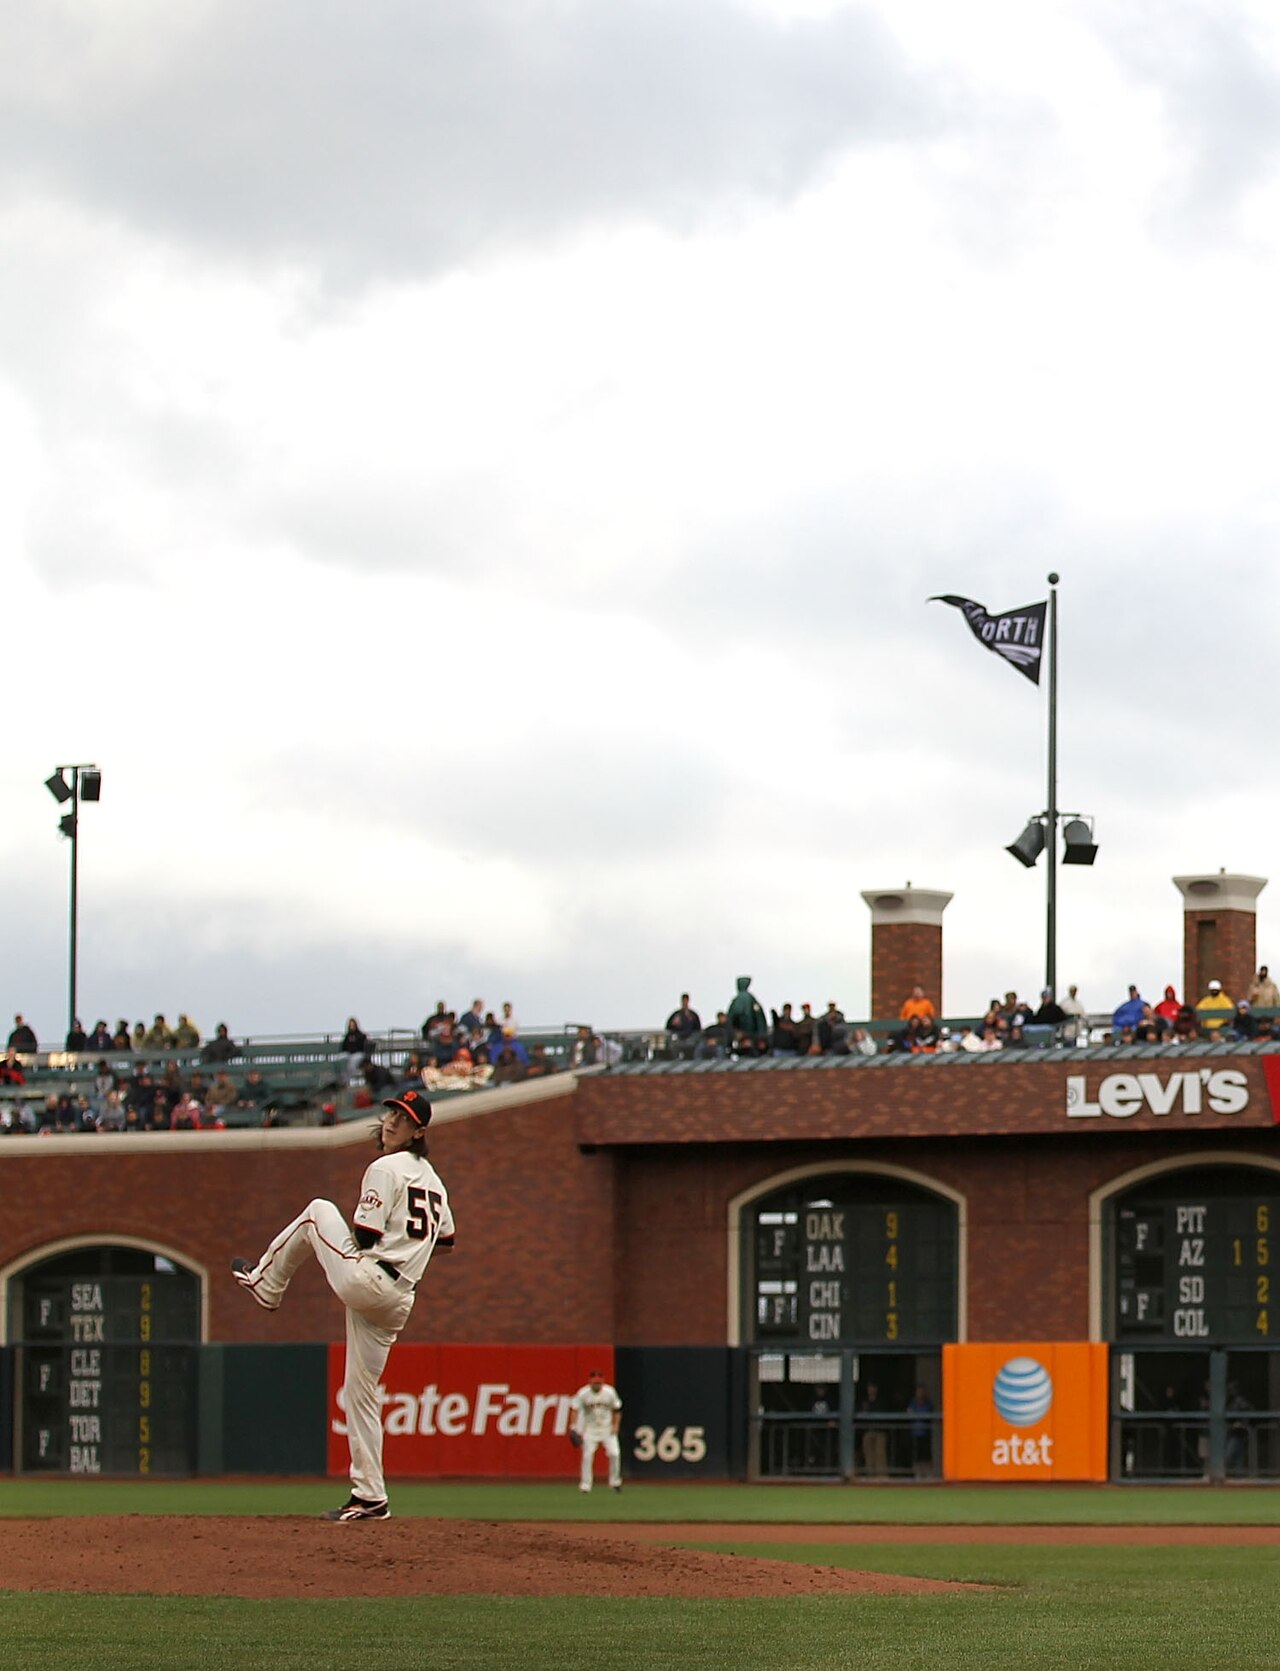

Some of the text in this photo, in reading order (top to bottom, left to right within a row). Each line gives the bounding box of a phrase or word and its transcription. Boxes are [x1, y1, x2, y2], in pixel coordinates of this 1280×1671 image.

[406, 1186, 441, 1241] 55
[1176, 1205, 1269, 1233] PIT 6
[1136, 1223, 1148, 1250] F
[807, 1245, 897, 1272] LAA 4
[1178, 1239, 1205, 1266] AZ
[71, 1284, 103, 1311] SEA
[810, 1281, 840, 1308] CHI
[1179, 1276, 1269, 1303] SD 2
[1137, 1293, 1149, 1320] F
[70, 1315, 104, 1342] TEX
[809, 1313, 840, 1340] CIN
[1174, 1309, 1268, 1336] COL 4
[71, 1350, 100, 1376] CLE
[69, 1381, 101, 1408] DET
[69, 1415, 100, 1442] TOR
[634, 1424, 706, 1462] 365
[991, 1434, 1053, 1466] at&t
